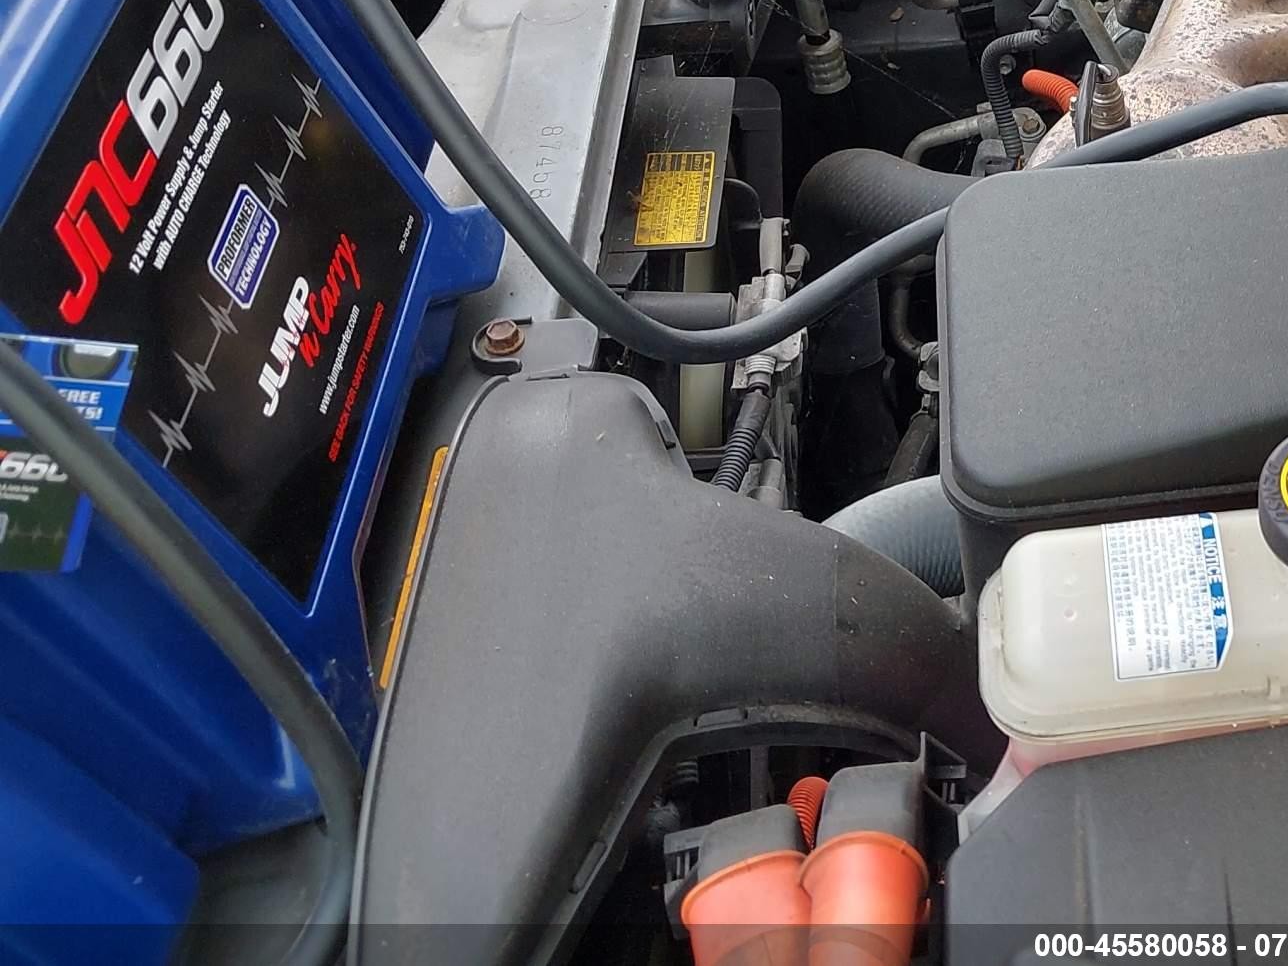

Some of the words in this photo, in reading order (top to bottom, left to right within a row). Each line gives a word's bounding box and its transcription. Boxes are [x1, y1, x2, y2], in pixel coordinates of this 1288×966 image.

[201, 80, 224, 120] Starter
[183, 145, 194, 161] &
[188, 117, 209, 150] Jump
[152, 244, 171, 272] with
[165, 207, 185, 249] AUTO
[178, 163, 205, 215] CHARGE
[199, 109, 231, 169] Technology
[165, 155, 191, 197] Supply
[148, 193, 172, 234] Power
[136, 231, 156, 262] Volt
[217, 199, 256, 278] PROFORMER
[235, 215, 272, 296] TECHNOLOGY
[129, 250, 144, 275] 12
[258, 276, 310, 418] JUMP
[319, 304, 360, 415] www.jumpstarter.com
[349, 351, 370, 389] SAFETY
[343, 388, 358, 411] FOR
[1203, 538, 1221, 584] NOTICE
